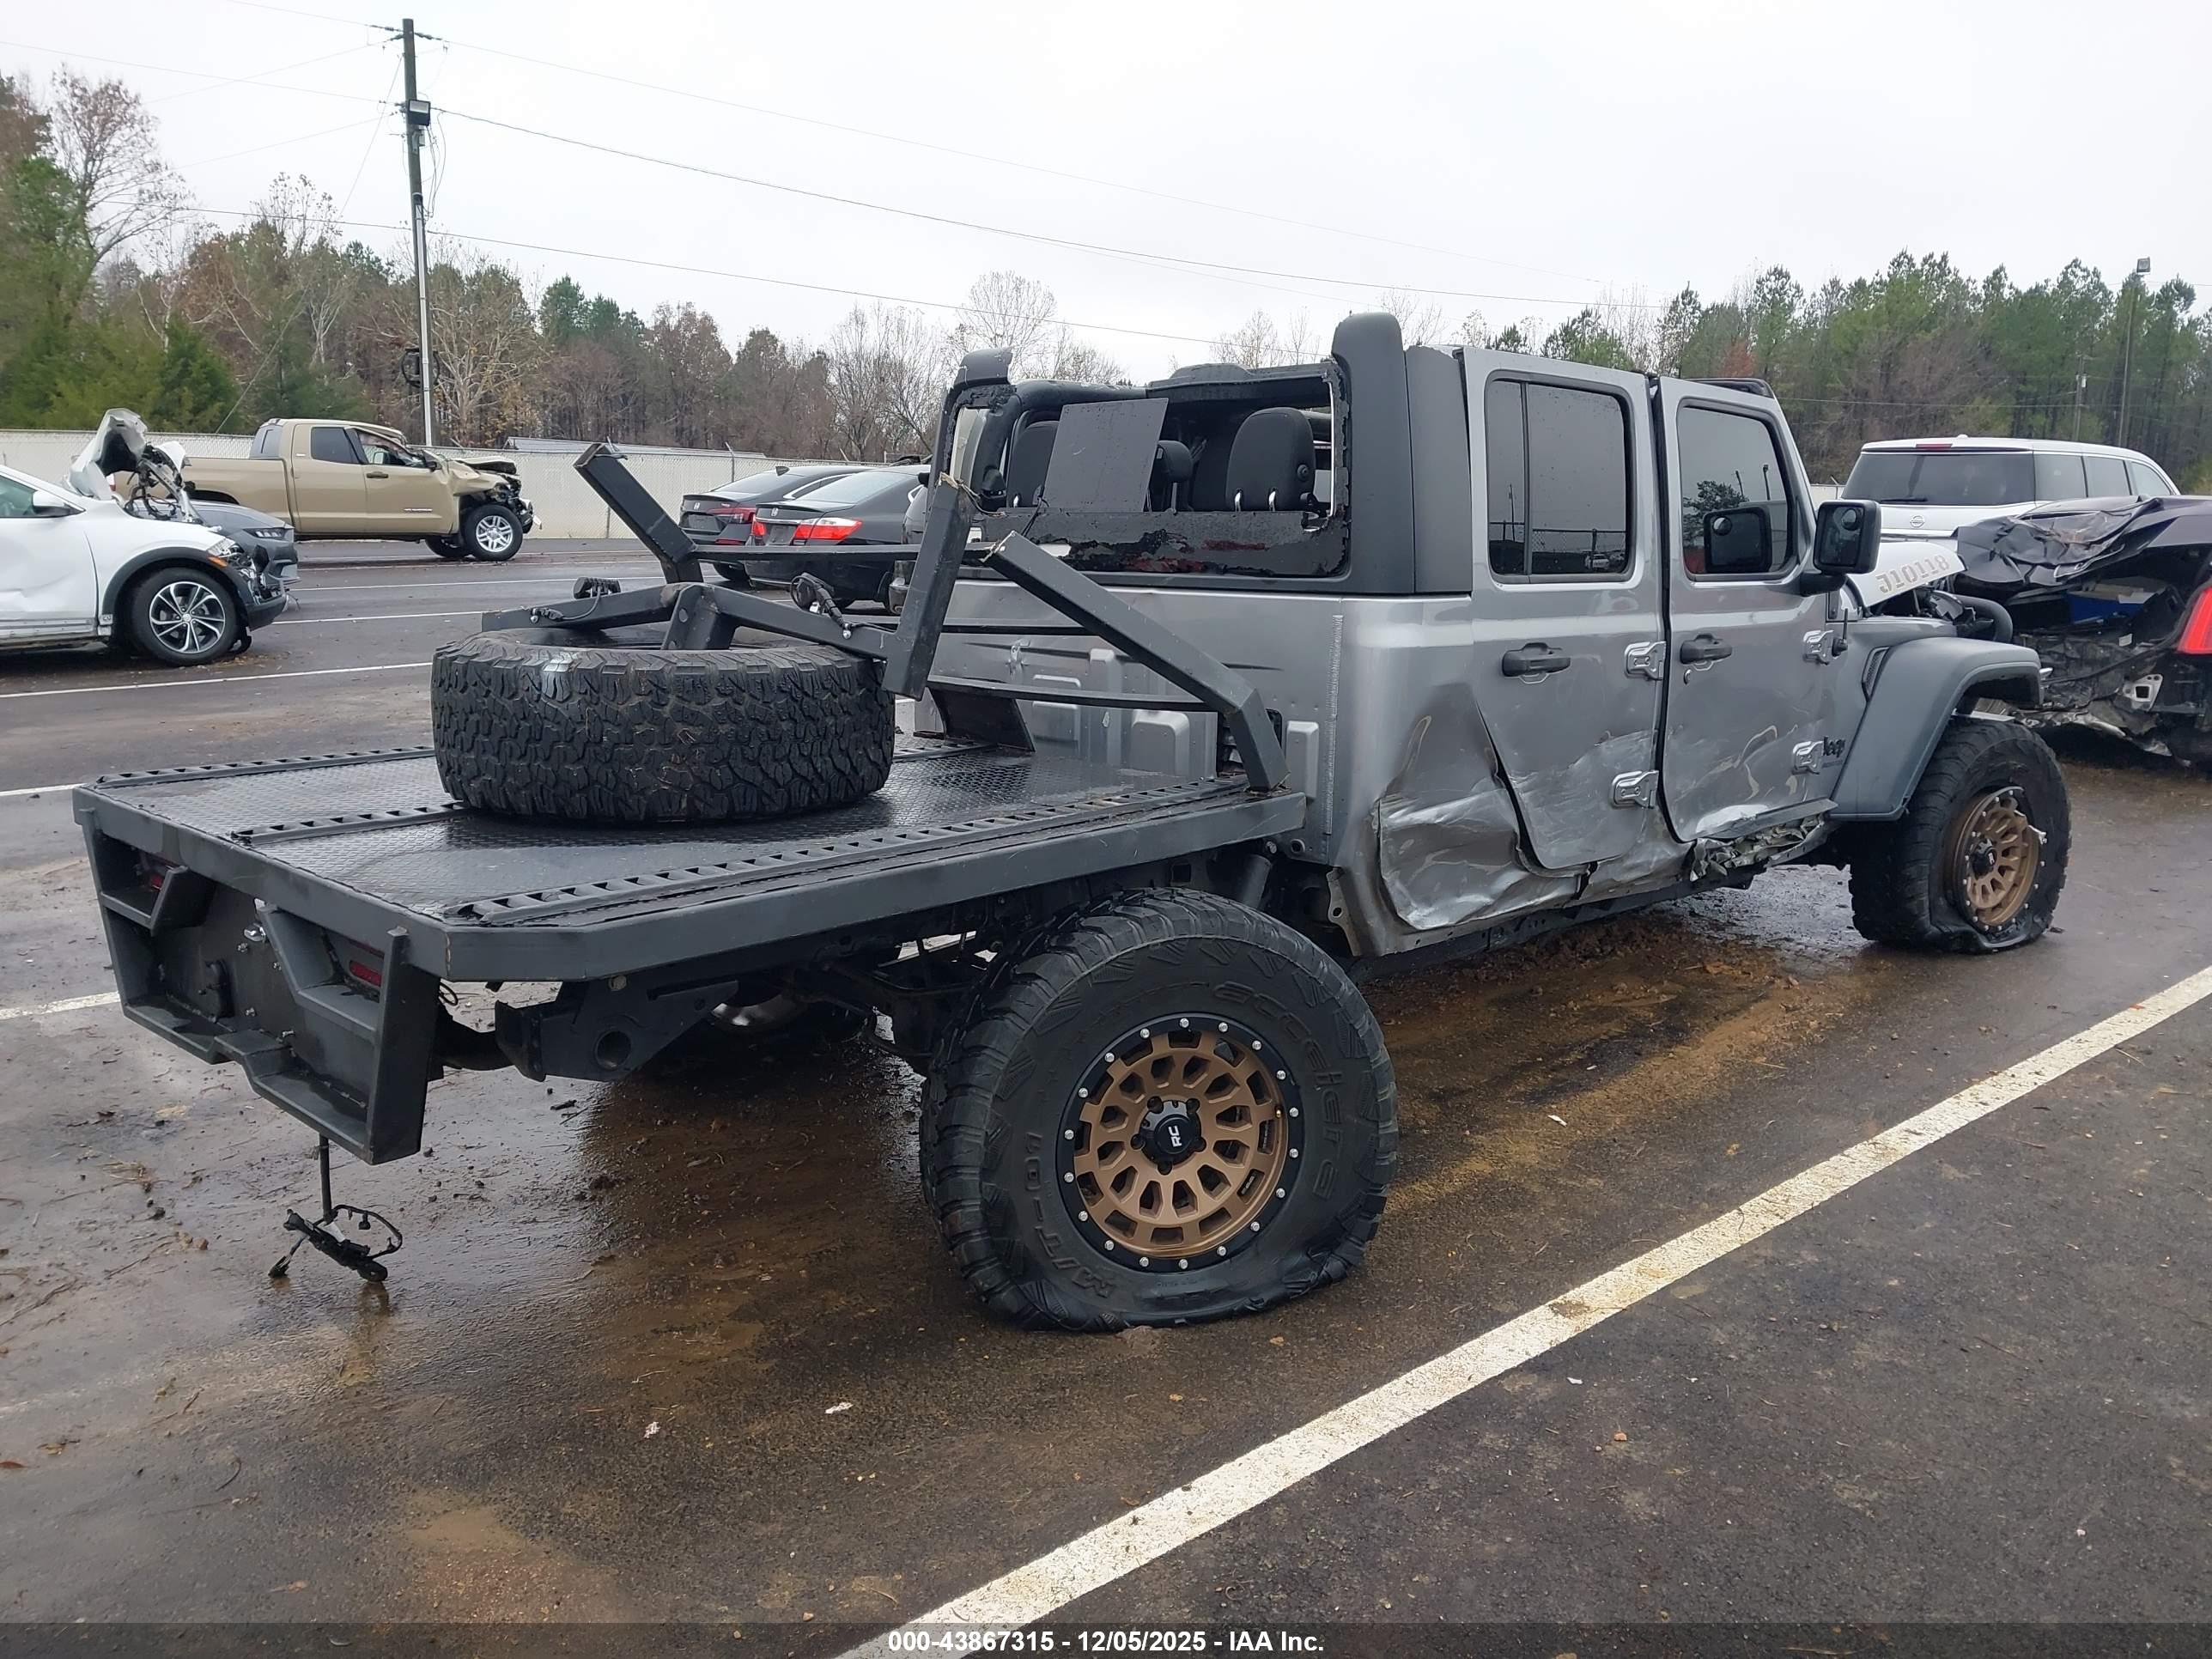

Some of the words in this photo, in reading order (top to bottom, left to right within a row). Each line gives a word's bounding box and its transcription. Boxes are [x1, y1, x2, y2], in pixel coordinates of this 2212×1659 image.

[1875, 555, 1950, 593] J10118
[1823, 737, 1846, 758] Jeep
[1168, 1125, 1182, 1147] RC
